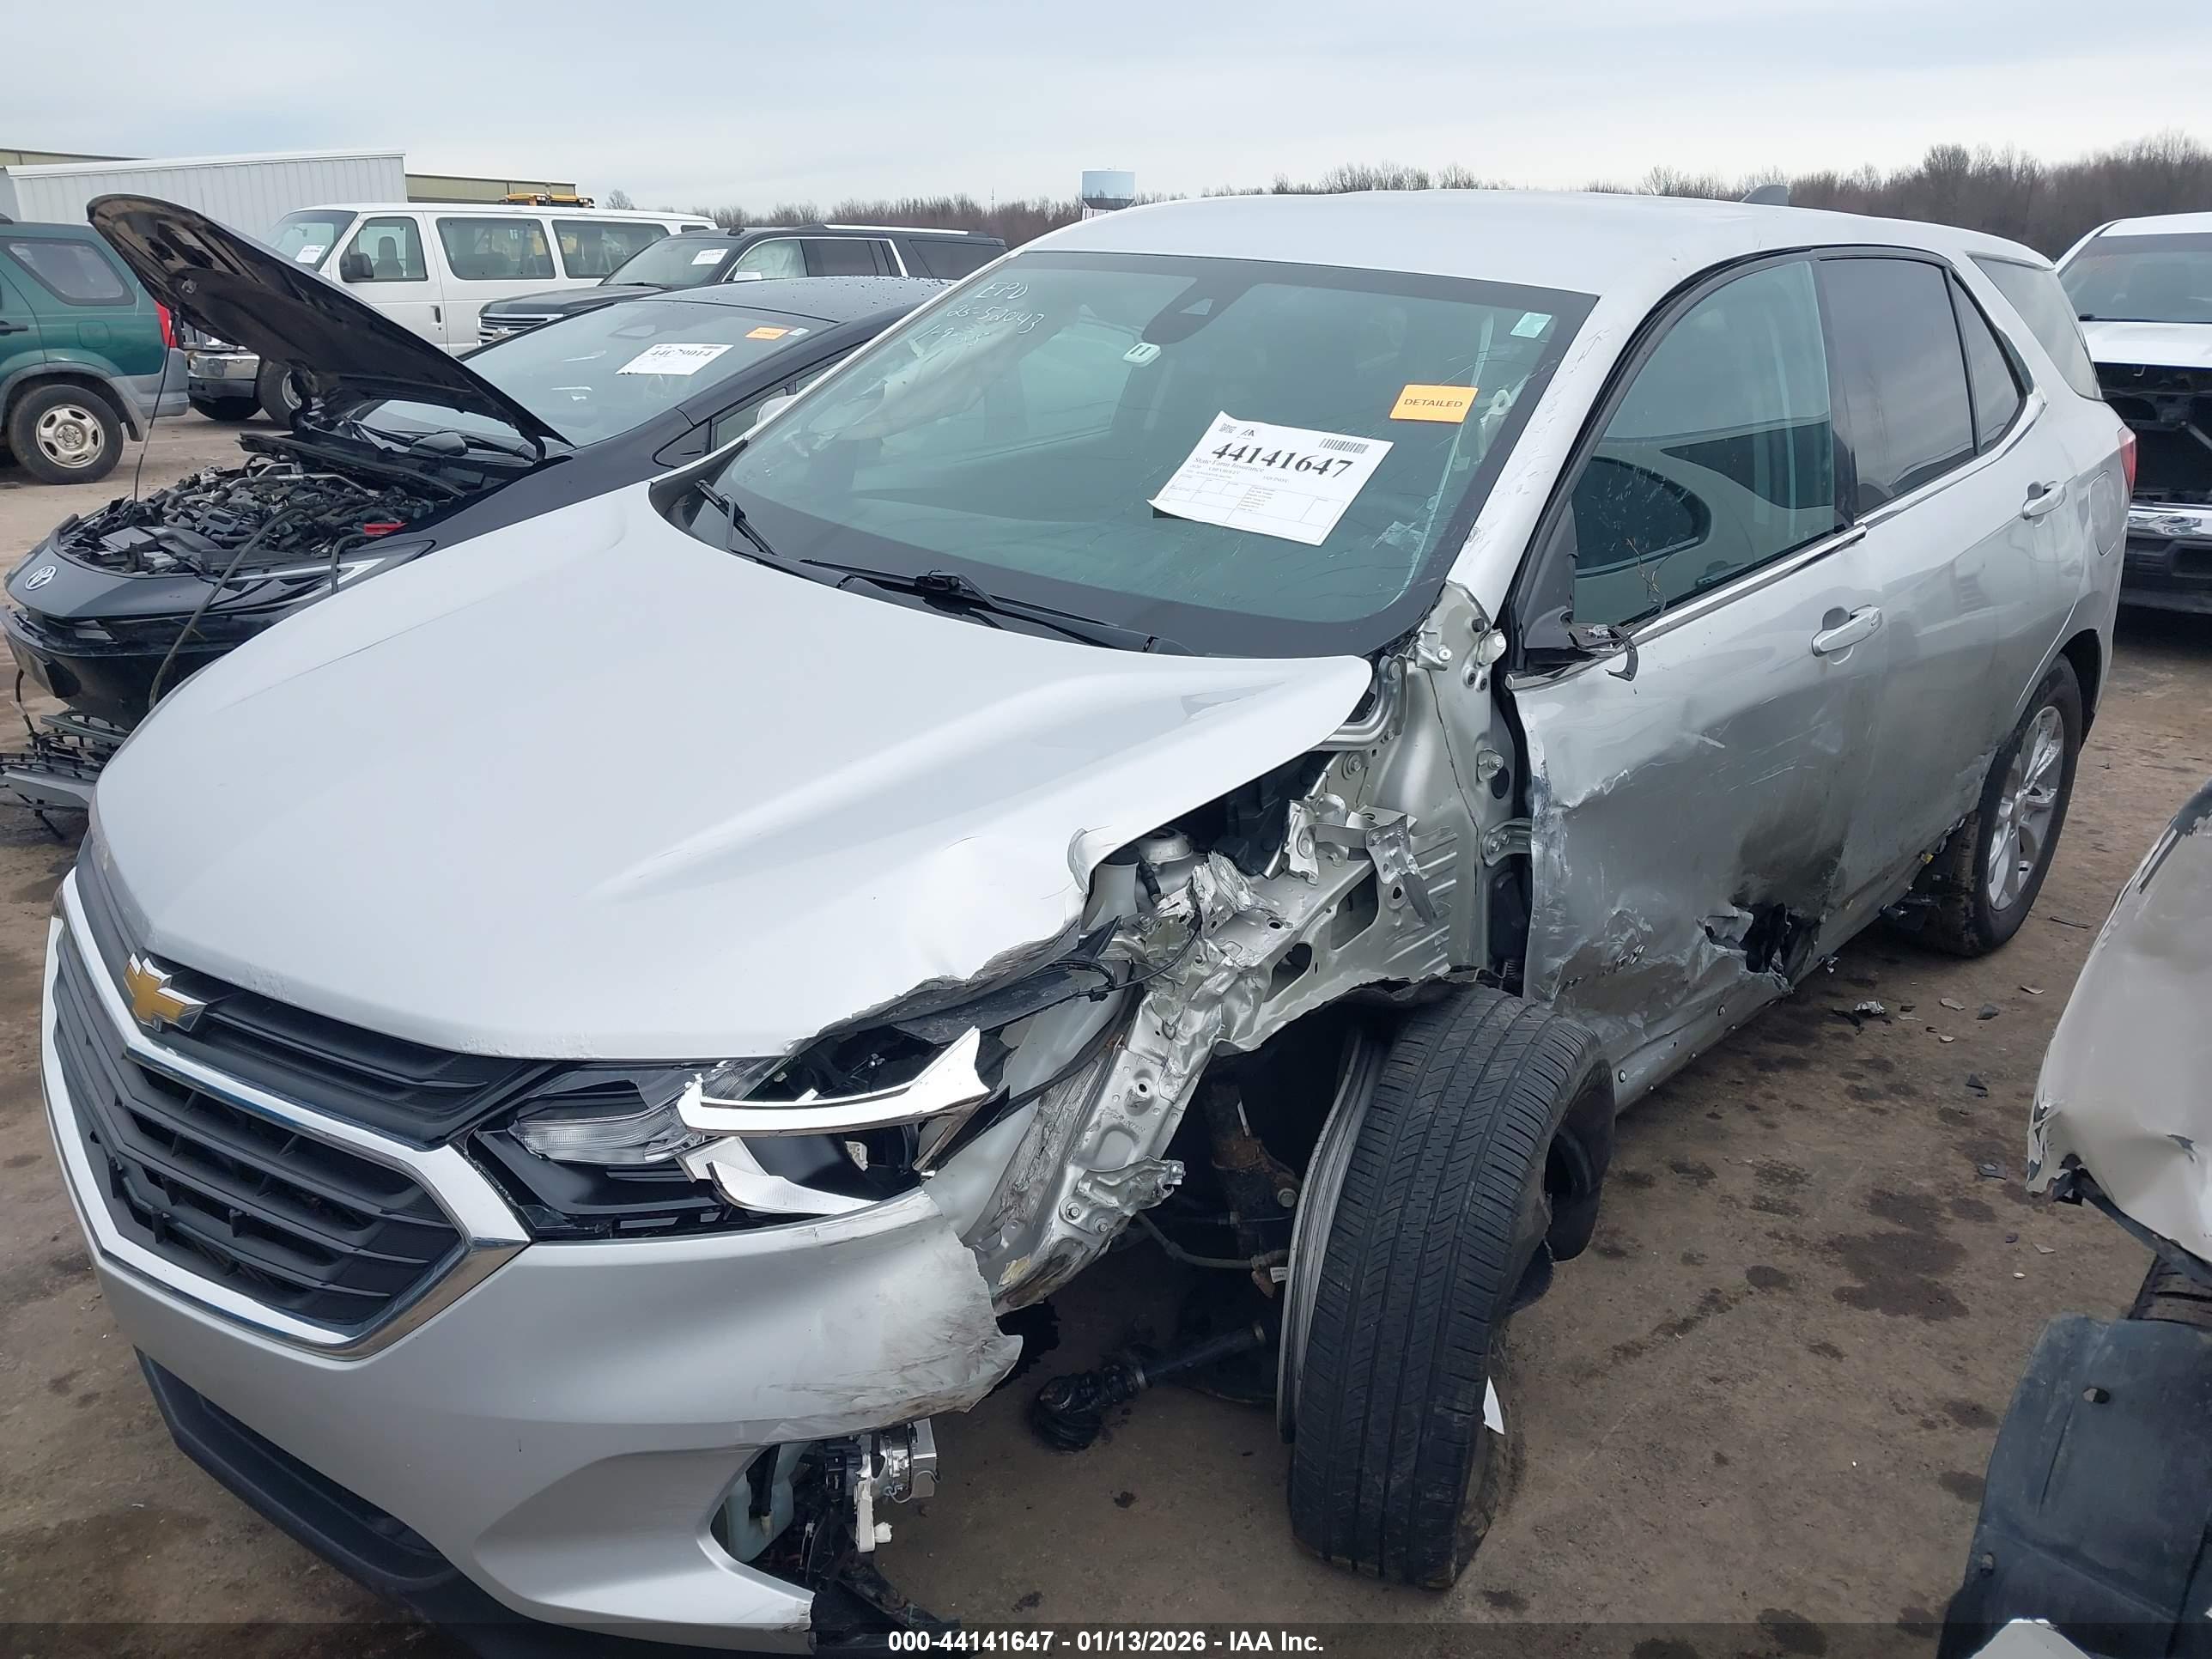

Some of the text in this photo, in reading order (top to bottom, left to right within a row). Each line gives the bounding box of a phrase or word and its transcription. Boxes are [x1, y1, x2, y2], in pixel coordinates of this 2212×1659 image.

[1402, 398, 1464, 409] DETAILED
[1211, 441, 1354, 478] 44141647
[1212, 459, 1231, 468] Farm
[1231, 463, 1265, 474] Insurance
